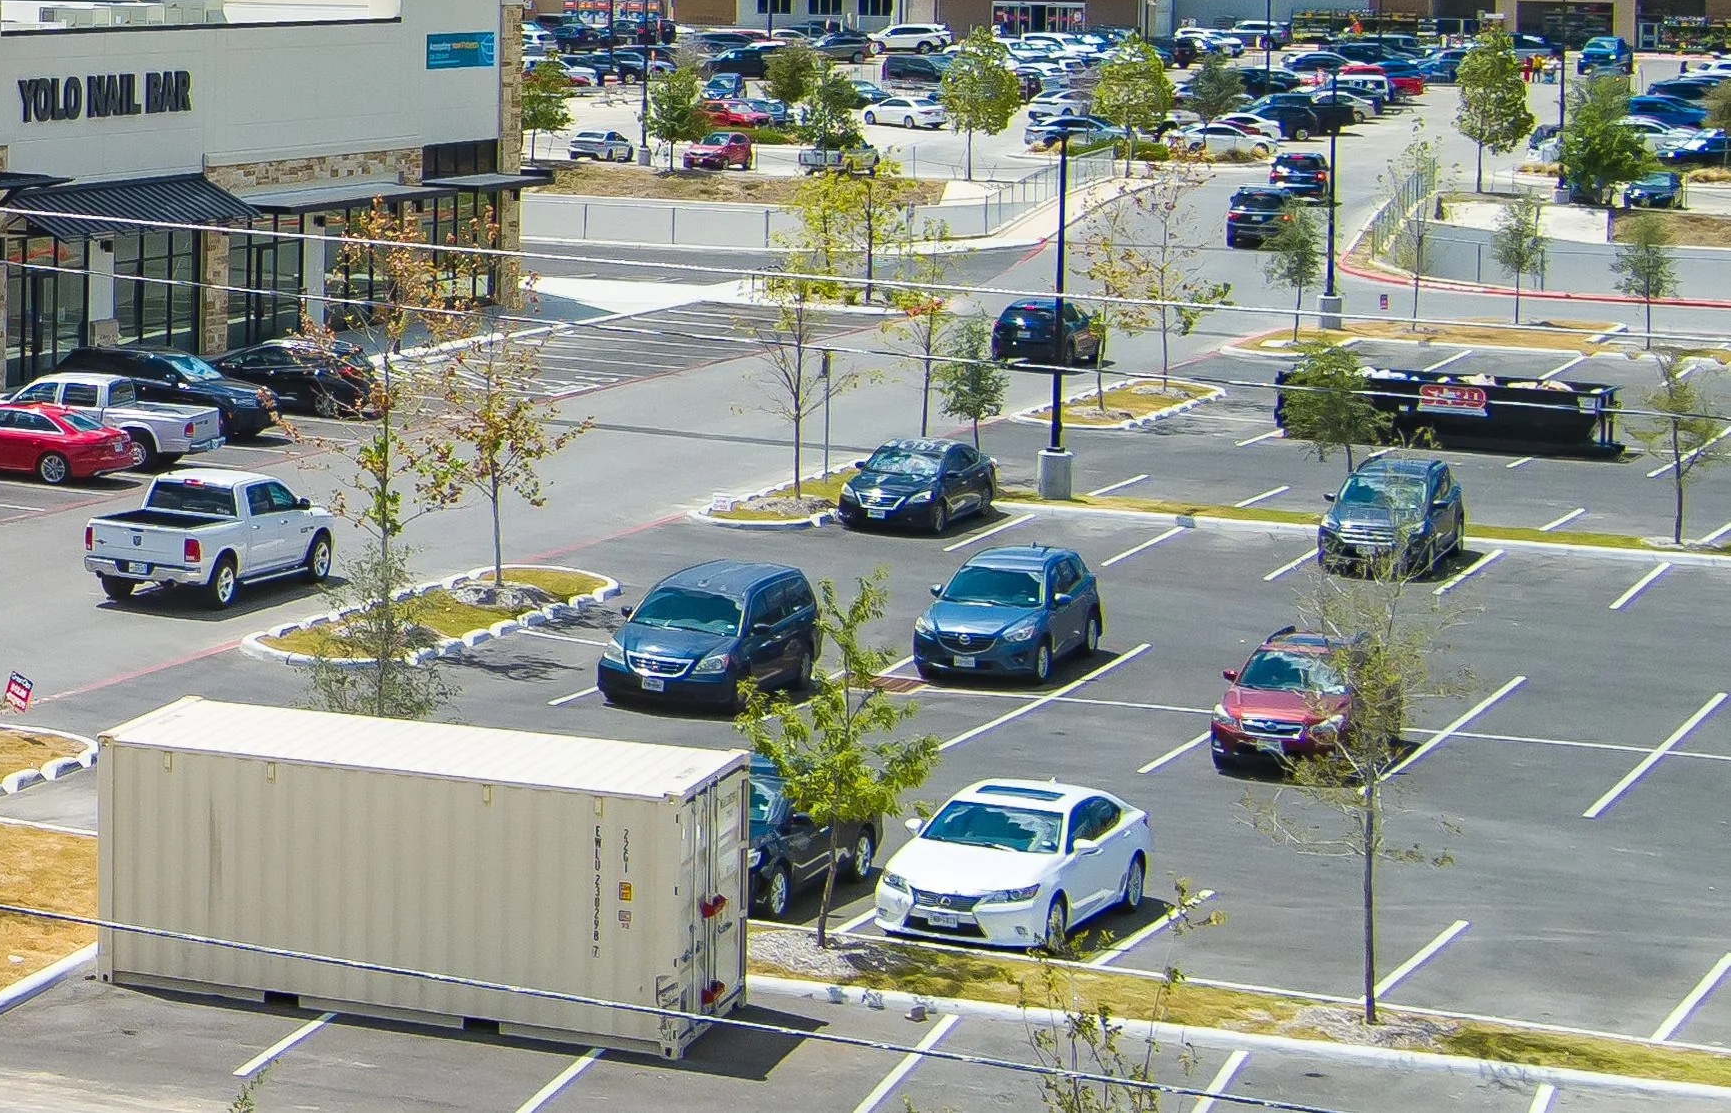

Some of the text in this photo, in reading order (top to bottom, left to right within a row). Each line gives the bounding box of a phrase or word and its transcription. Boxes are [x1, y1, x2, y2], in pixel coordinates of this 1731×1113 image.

[18, 70, 192, 123] YOLO NAIL BAR
